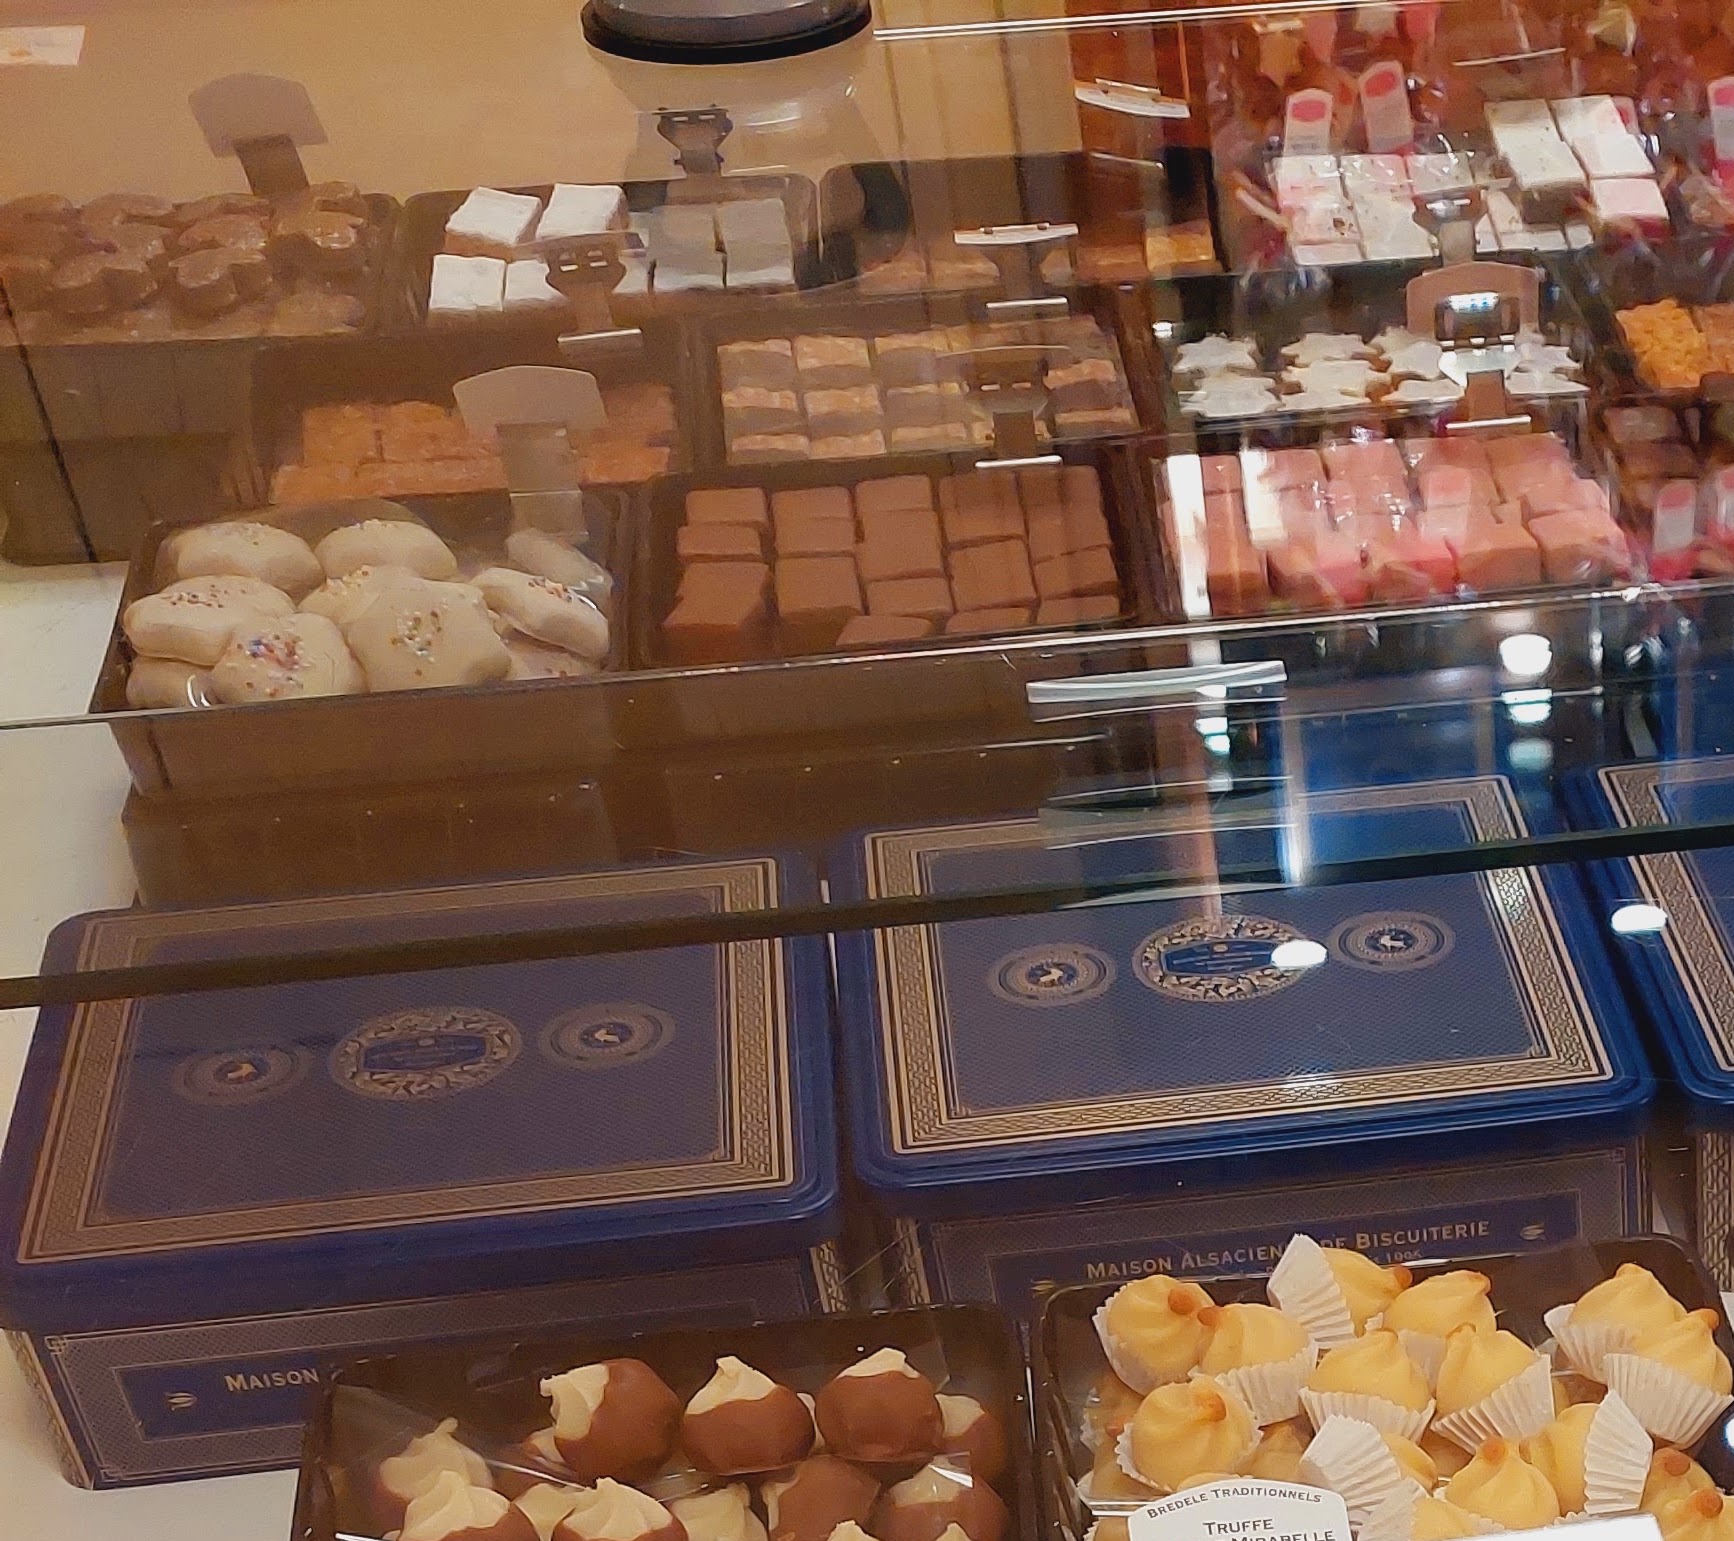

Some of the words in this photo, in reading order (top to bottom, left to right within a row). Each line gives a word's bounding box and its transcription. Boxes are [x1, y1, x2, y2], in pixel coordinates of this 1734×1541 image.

[1087, 1256, 1172, 1280] MAISON
[1356, 1221, 1490, 1250] BISCUITERIE
[224, 1367, 319, 1393] MAISON
[1147, 1492, 1208, 1519] BREDELE
[1211, 1487, 1322, 1503] TRADITIONNELS
[1203, 1518, 1274, 1536] TRUFFE
